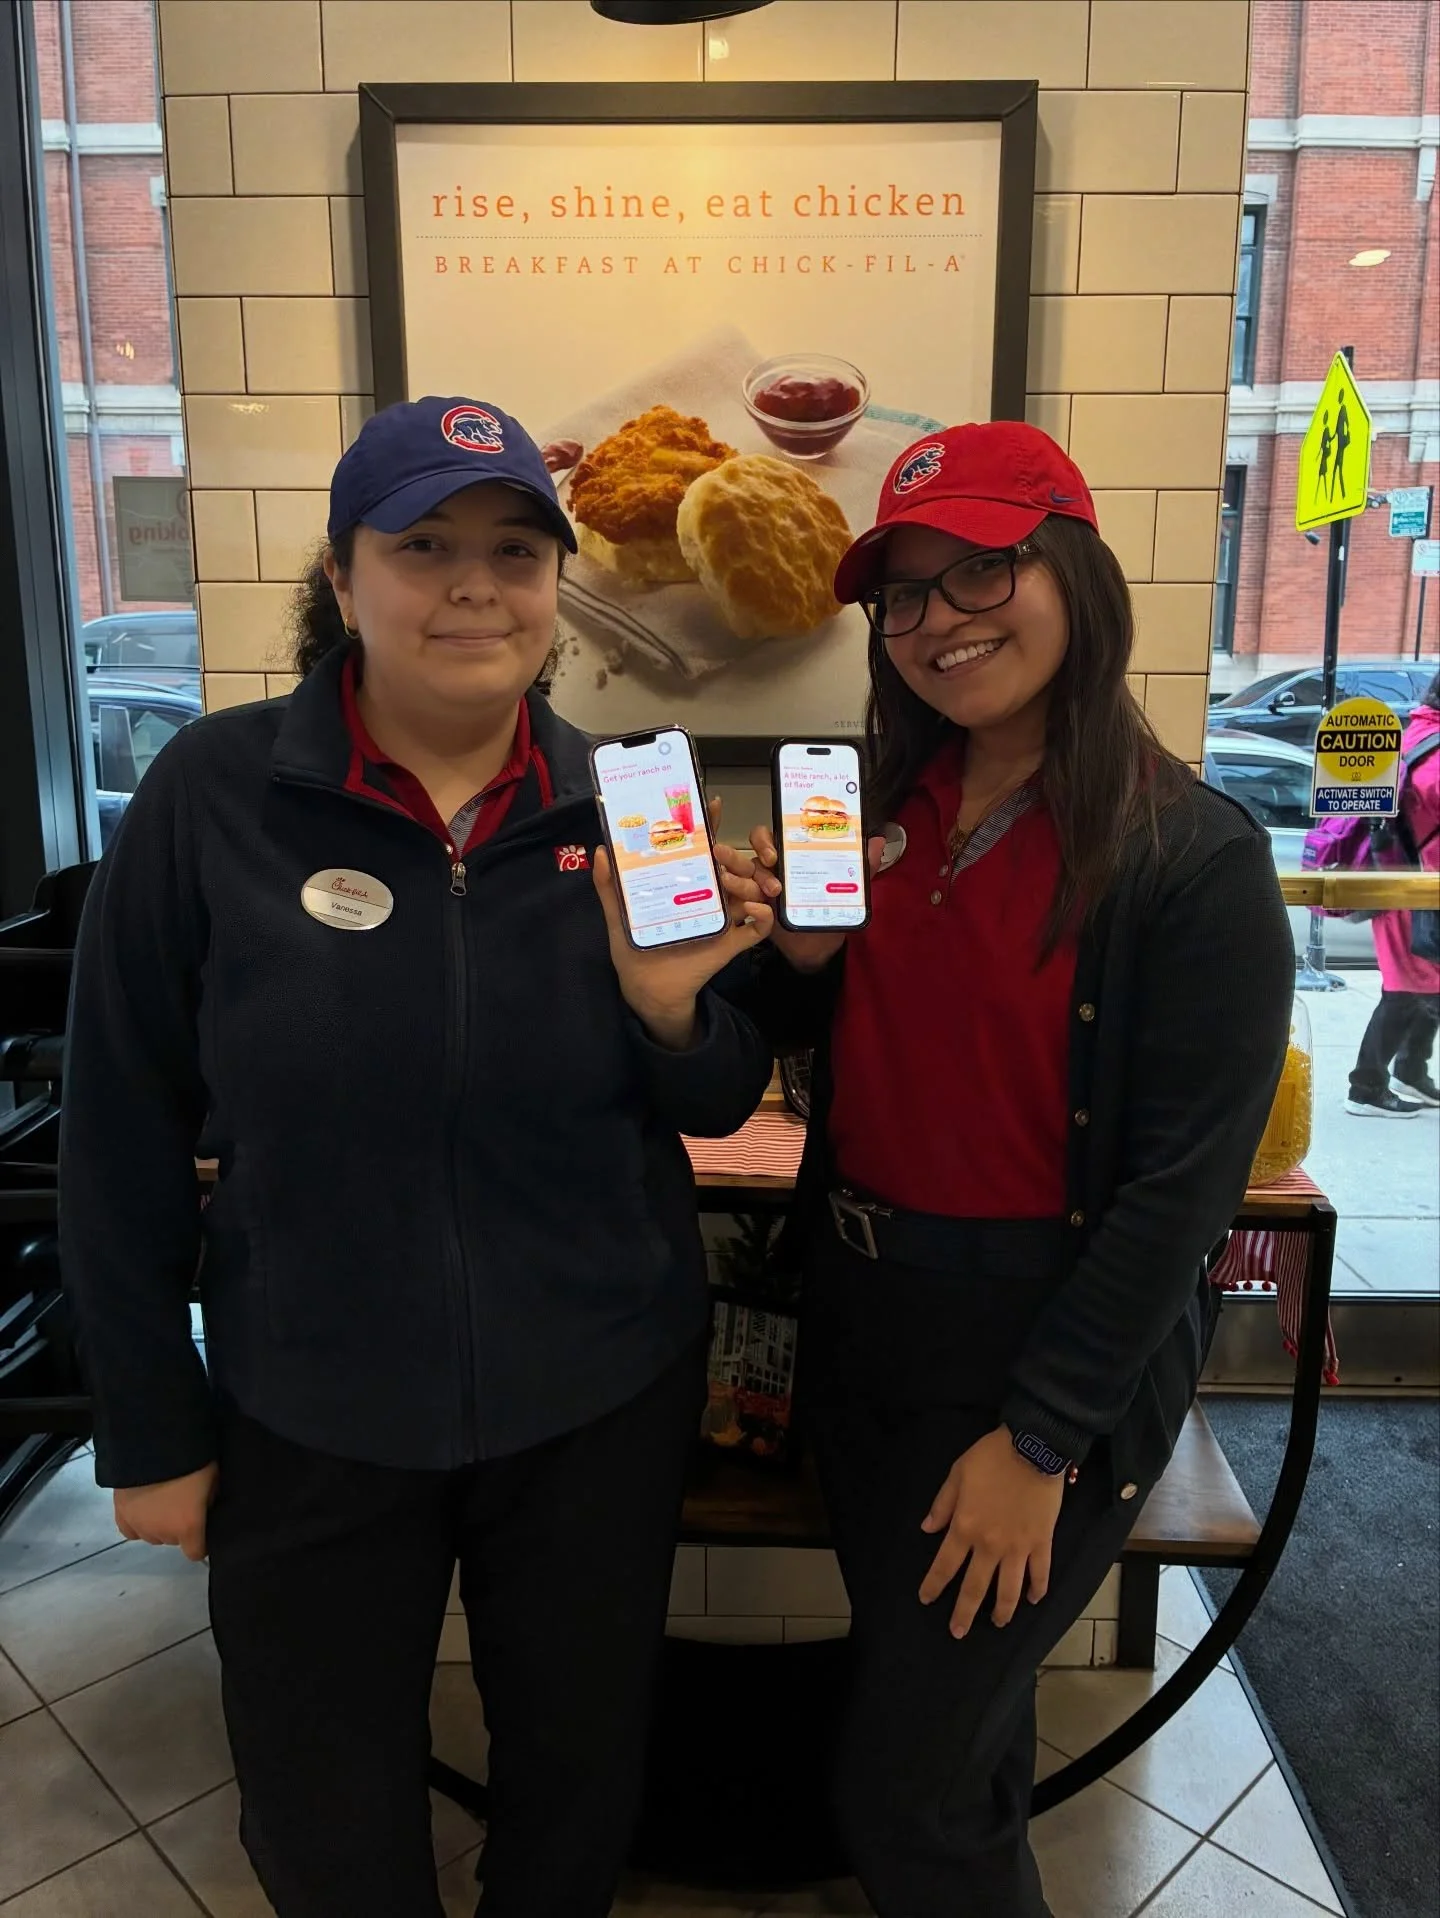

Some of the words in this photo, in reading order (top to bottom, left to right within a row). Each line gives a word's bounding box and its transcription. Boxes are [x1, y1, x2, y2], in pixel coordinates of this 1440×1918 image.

[431, 185, 530, 224] rise,
[550, 185, 685, 224] shine,
[706, 189, 773, 218] eat
[793, 184, 966, 218] chicken
[434, 255, 639, 274] BREAKFAST
[663, 255, 701, 274] AT
[727, 253, 960, 274] CHICK-FIL-A
[1326, 714, 1395, 727] AUTOMATIC
[1320, 733, 1397, 750] CAUTION
[1339, 755, 1375, 768] DOOR
[603, 775, 619, 784] Get
[638, 765, 660, 777] ranch
[661, 764, 672, 772] on
[1317, 788, 1358, 800] ACTIVATE
[1360, 788, 1393, 800] SWITCH
[1328, 800, 1340, 811] TO
[1341, 799, 1381, 811] OPERATE
[331, 901, 363, 917] Vanessa
